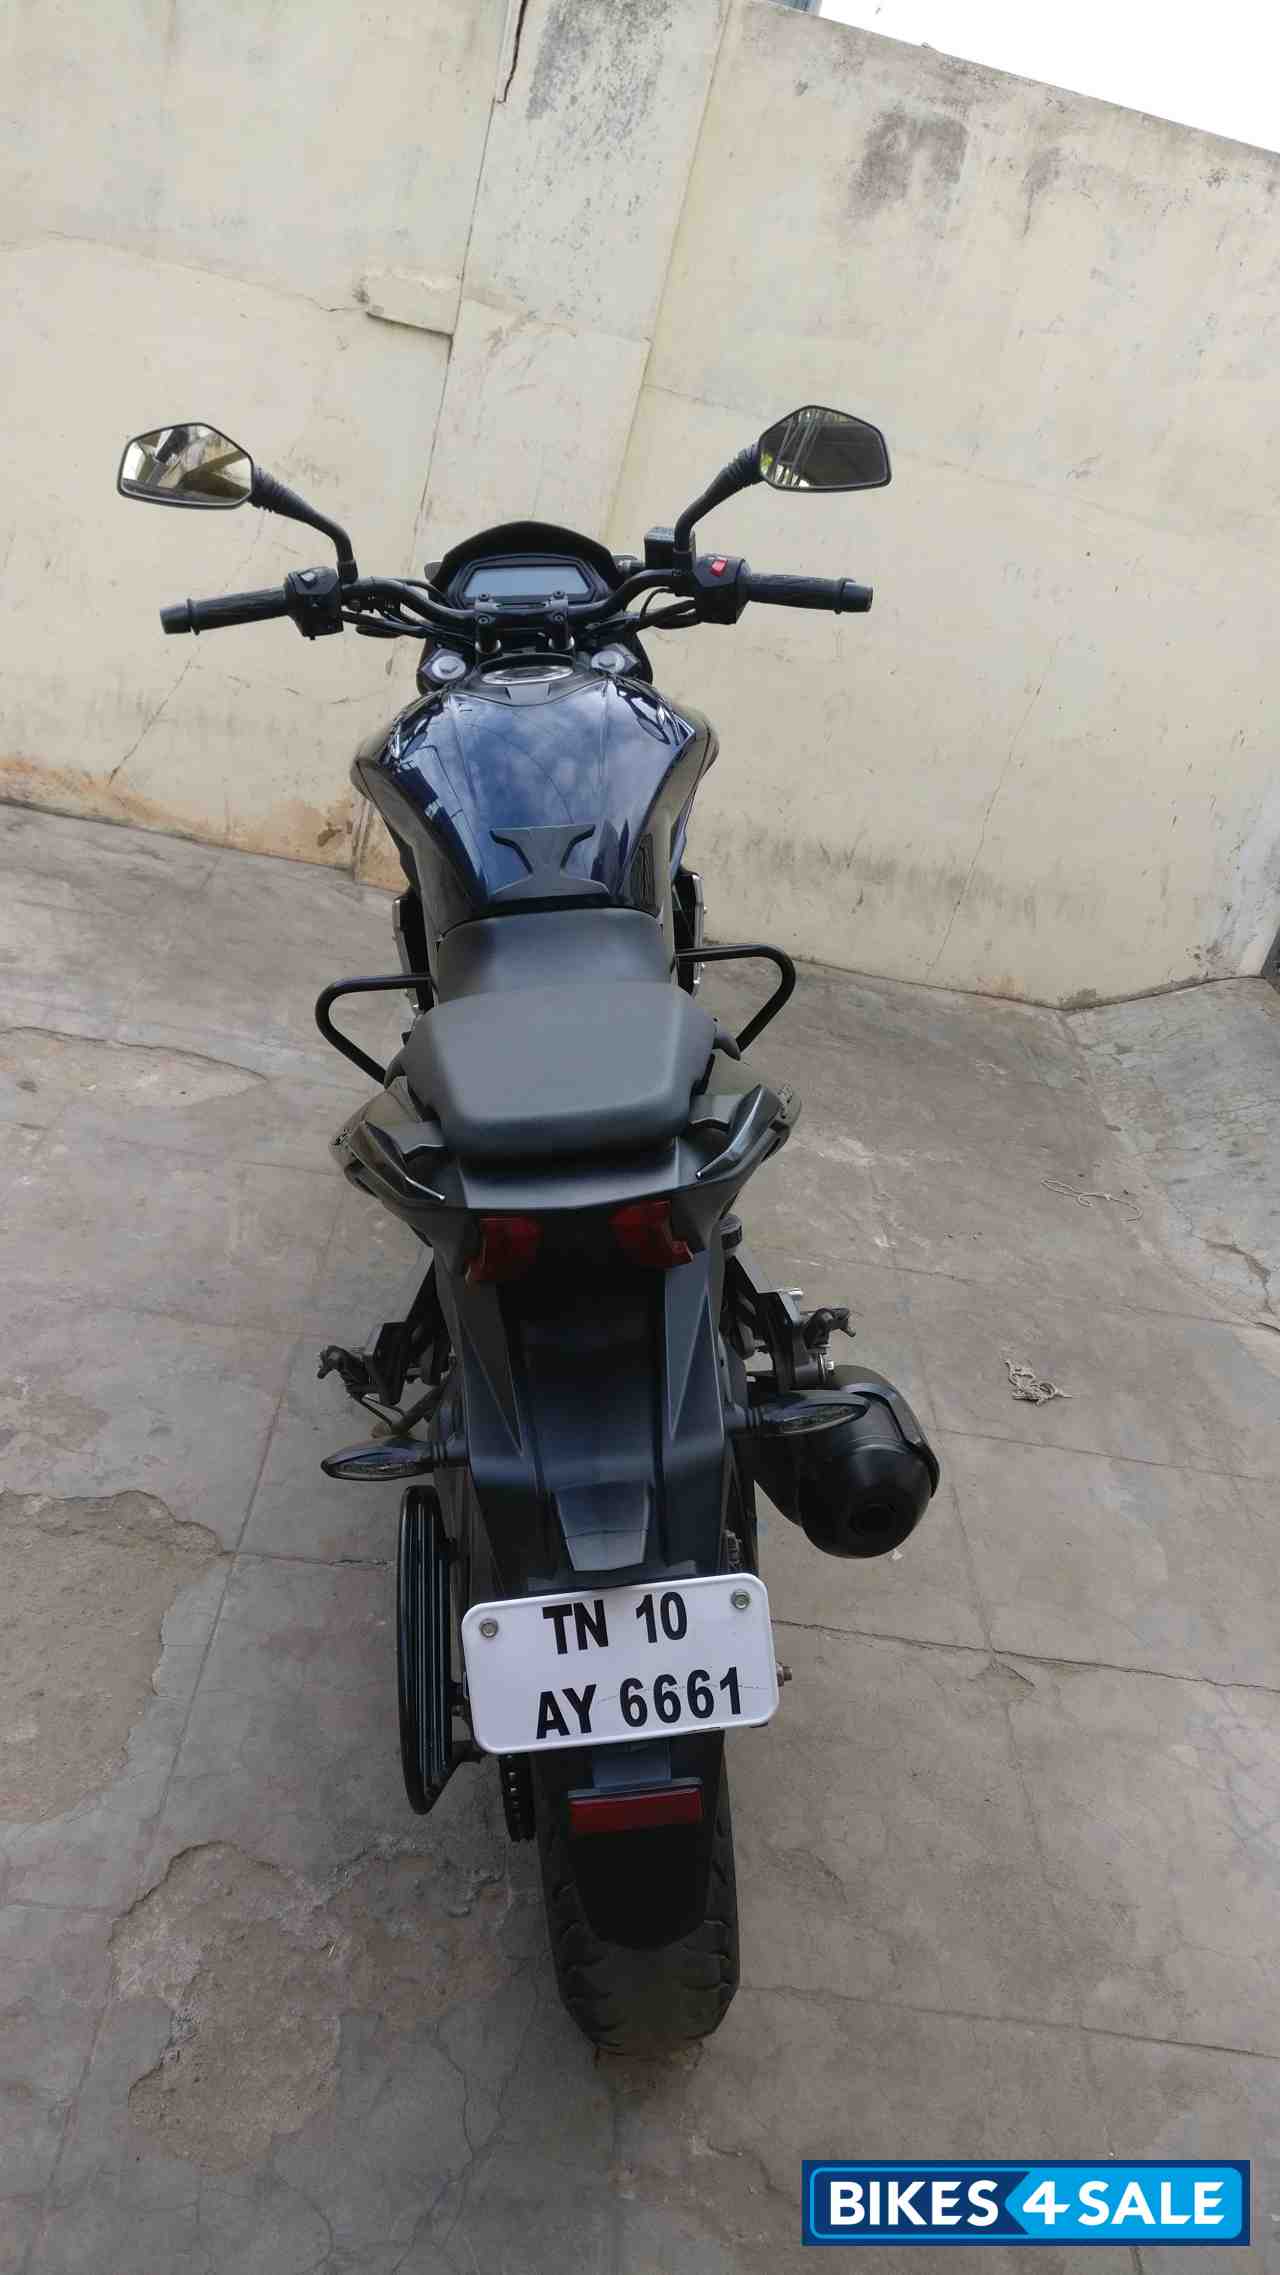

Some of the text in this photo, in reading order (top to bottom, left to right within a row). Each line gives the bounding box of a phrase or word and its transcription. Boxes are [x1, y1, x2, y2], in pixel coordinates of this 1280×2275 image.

[542, 1592, 687, 1654] TN 10
[536, 1667, 741, 1739] AY 6661
